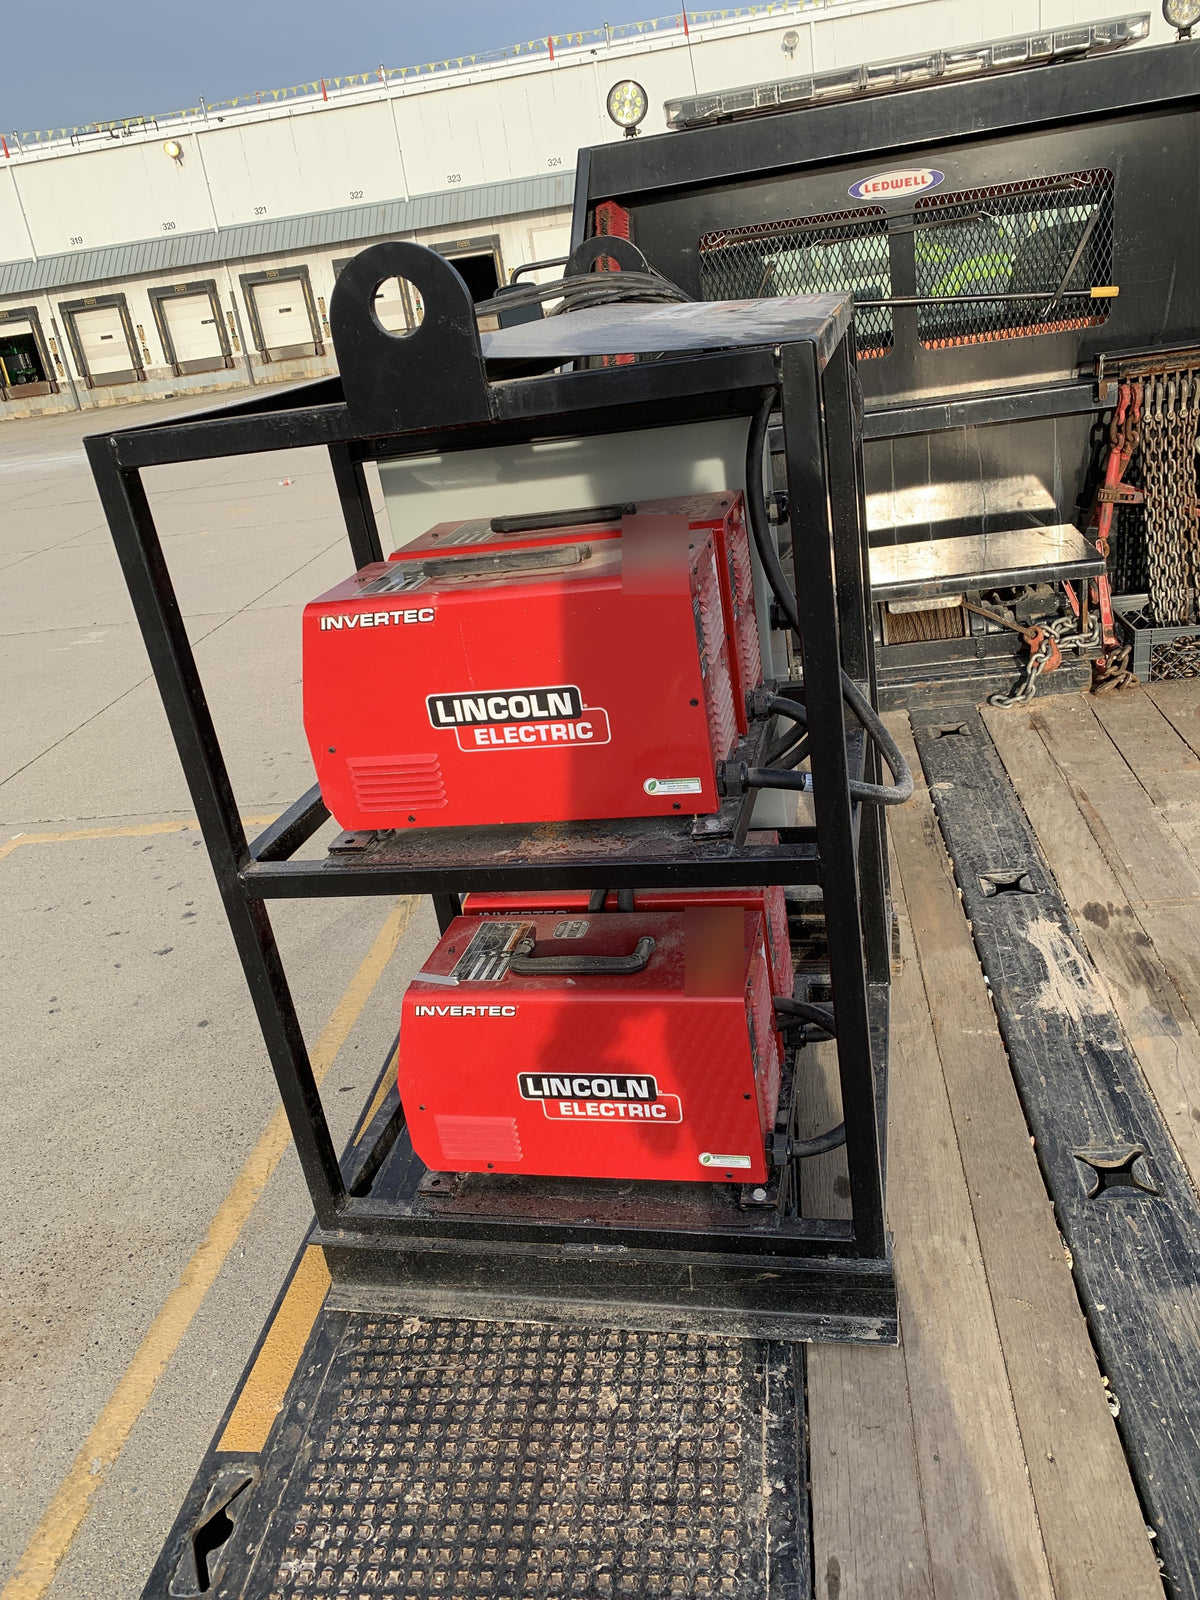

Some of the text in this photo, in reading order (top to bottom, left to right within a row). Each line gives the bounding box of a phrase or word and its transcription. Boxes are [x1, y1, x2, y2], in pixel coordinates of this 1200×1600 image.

[547, 157, 562, 167] 324
[447, 174, 462, 184] 323
[864, 175, 928, 194] LEDWELL
[349, 190, 364, 200] 322
[254, 206, 267, 215] 321
[162, 221, 176, 231] 320
[70, 236, 83, 246] 319
[320, 607, 435, 631] INVERTEC
[435, 692, 574, 724] LINCOLN
[473, 722, 594, 746] ELECTRIC
[415, 1005, 516, 1017] INVERTEC
[525, 1077, 650, 1098] LINCOLN
[559, 1102, 667, 1118] ELECTRIC
